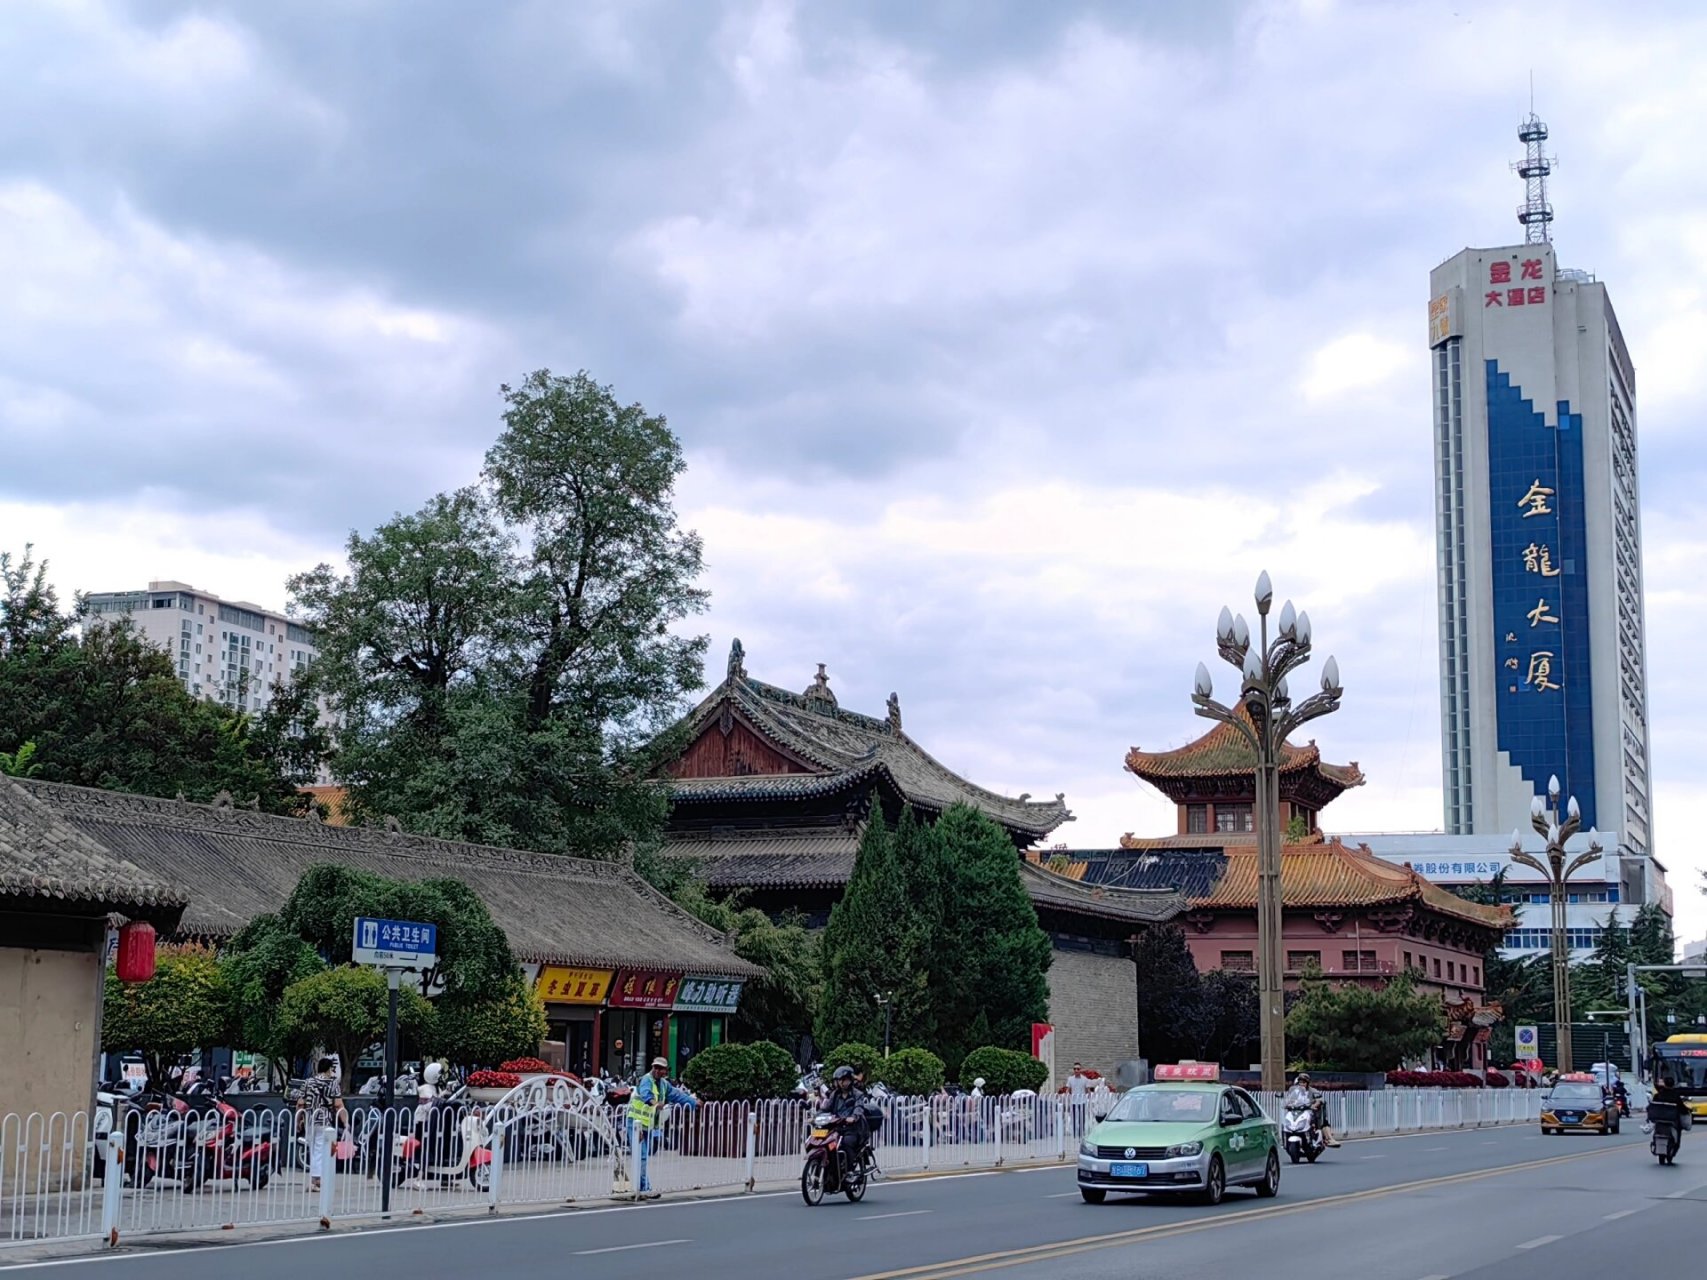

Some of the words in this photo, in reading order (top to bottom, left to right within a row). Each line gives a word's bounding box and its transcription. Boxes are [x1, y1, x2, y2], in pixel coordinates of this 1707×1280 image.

[1490, 259, 1543, 284] 金龙
[1485, 286, 1545, 308] 大酒店
[381, 924, 430, 945] 公共卫生间
[547, 979, 601, 997] 冬虫夏草
[681, 980, 741, 1005] 峰力助听器
